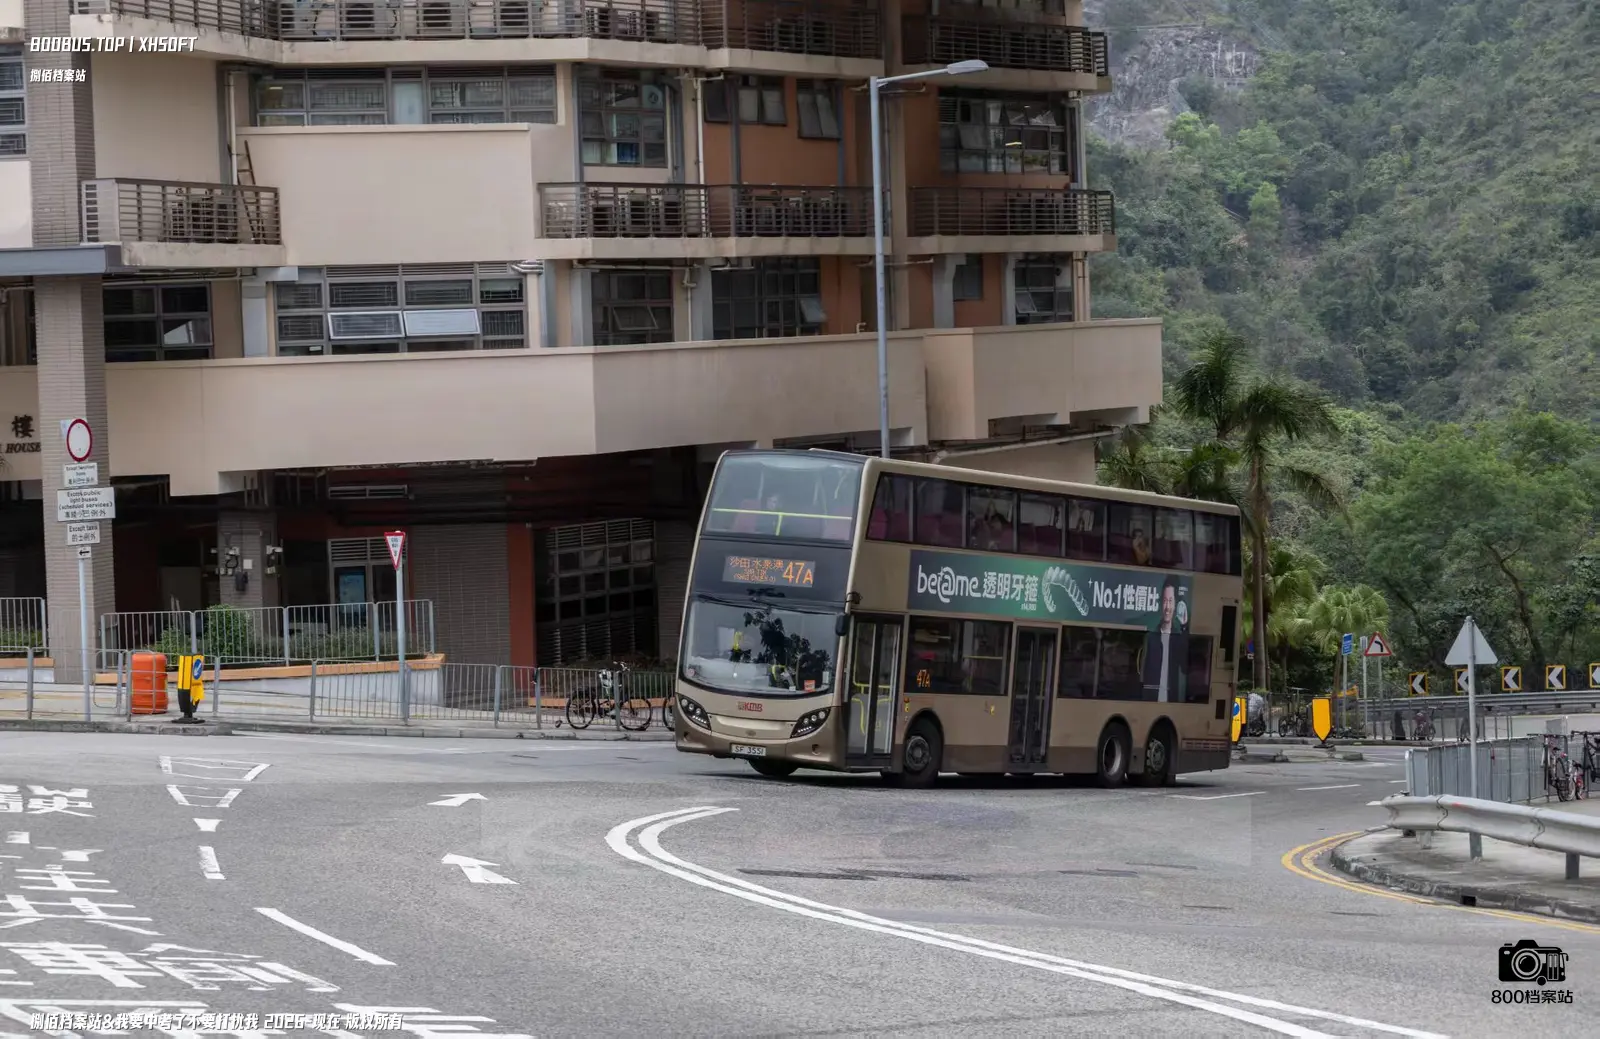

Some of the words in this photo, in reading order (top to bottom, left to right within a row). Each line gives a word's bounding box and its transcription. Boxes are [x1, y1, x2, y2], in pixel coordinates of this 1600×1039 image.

[12, 414, 35, 438] 樓
[5, 442, 41, 454] HOUSE
[782, 561, 813, 585] 47A
[982, 571, 1039, 602] 透明牙箍
[916, 669, 931, 688] 47A
[744, 702, 763, 712] KMB
[735, 745, 745, 753] SF
[747, 747, 764, 755] 3551
